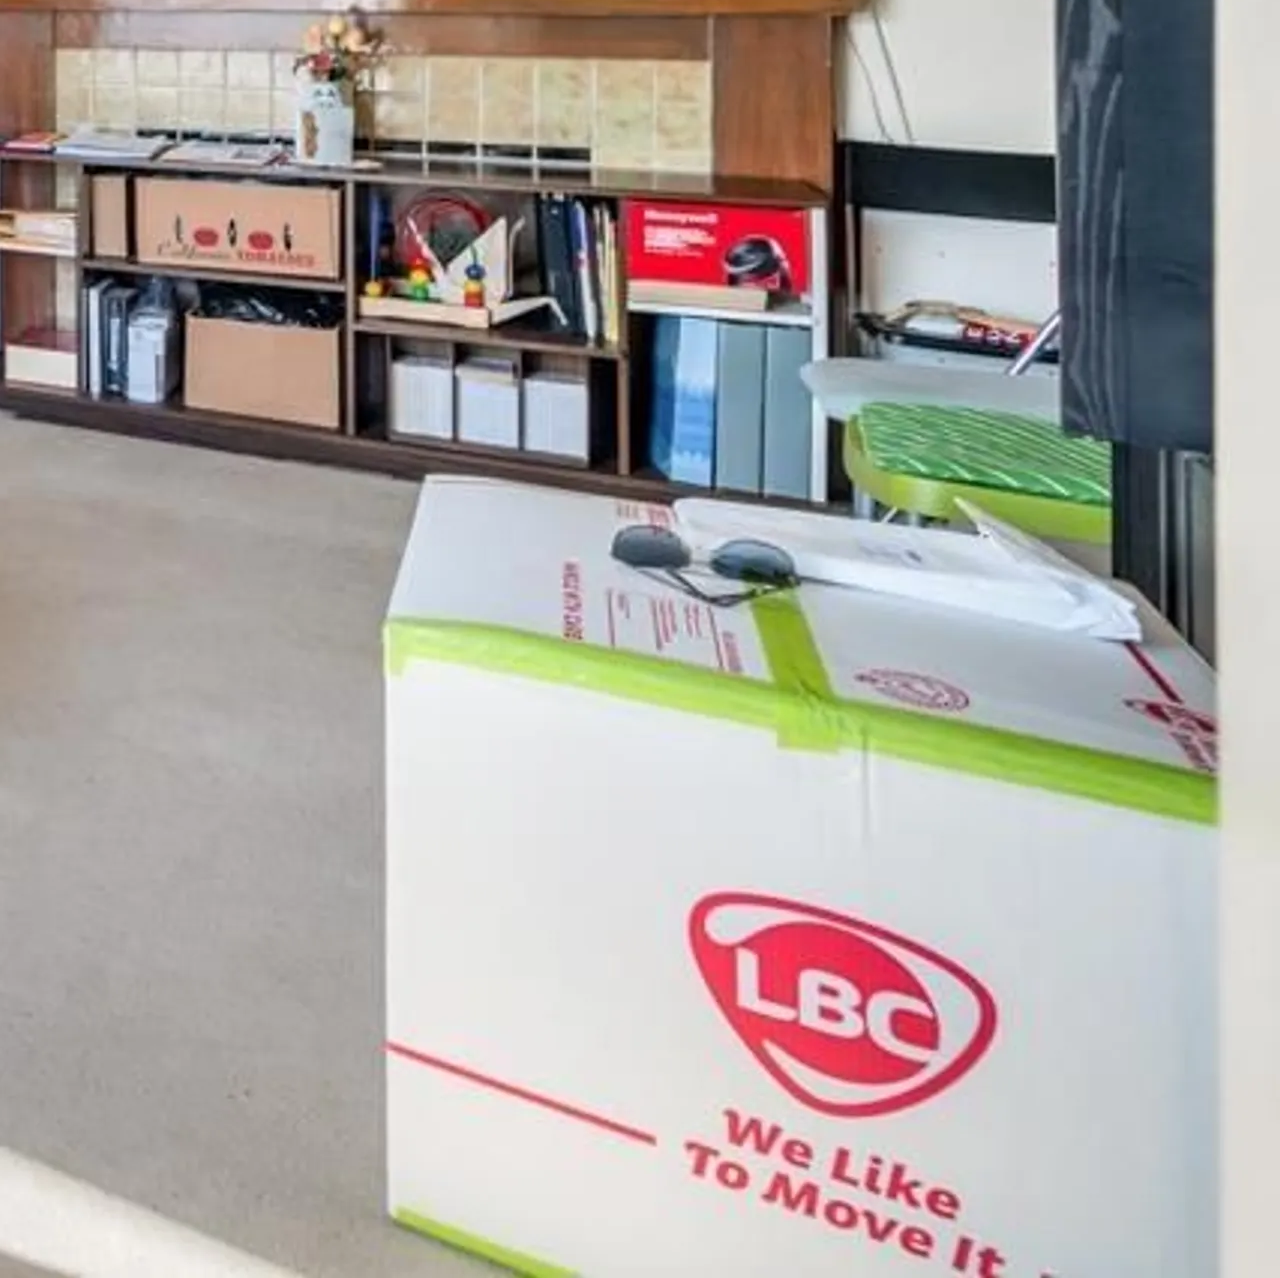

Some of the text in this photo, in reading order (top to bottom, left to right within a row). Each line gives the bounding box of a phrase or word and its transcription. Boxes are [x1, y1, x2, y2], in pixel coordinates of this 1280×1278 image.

[735, 946, 939, 1063] LBC
[685, 1141, 1005, 1278] To Move It
[723, 1108, 961, 1220] We Like
